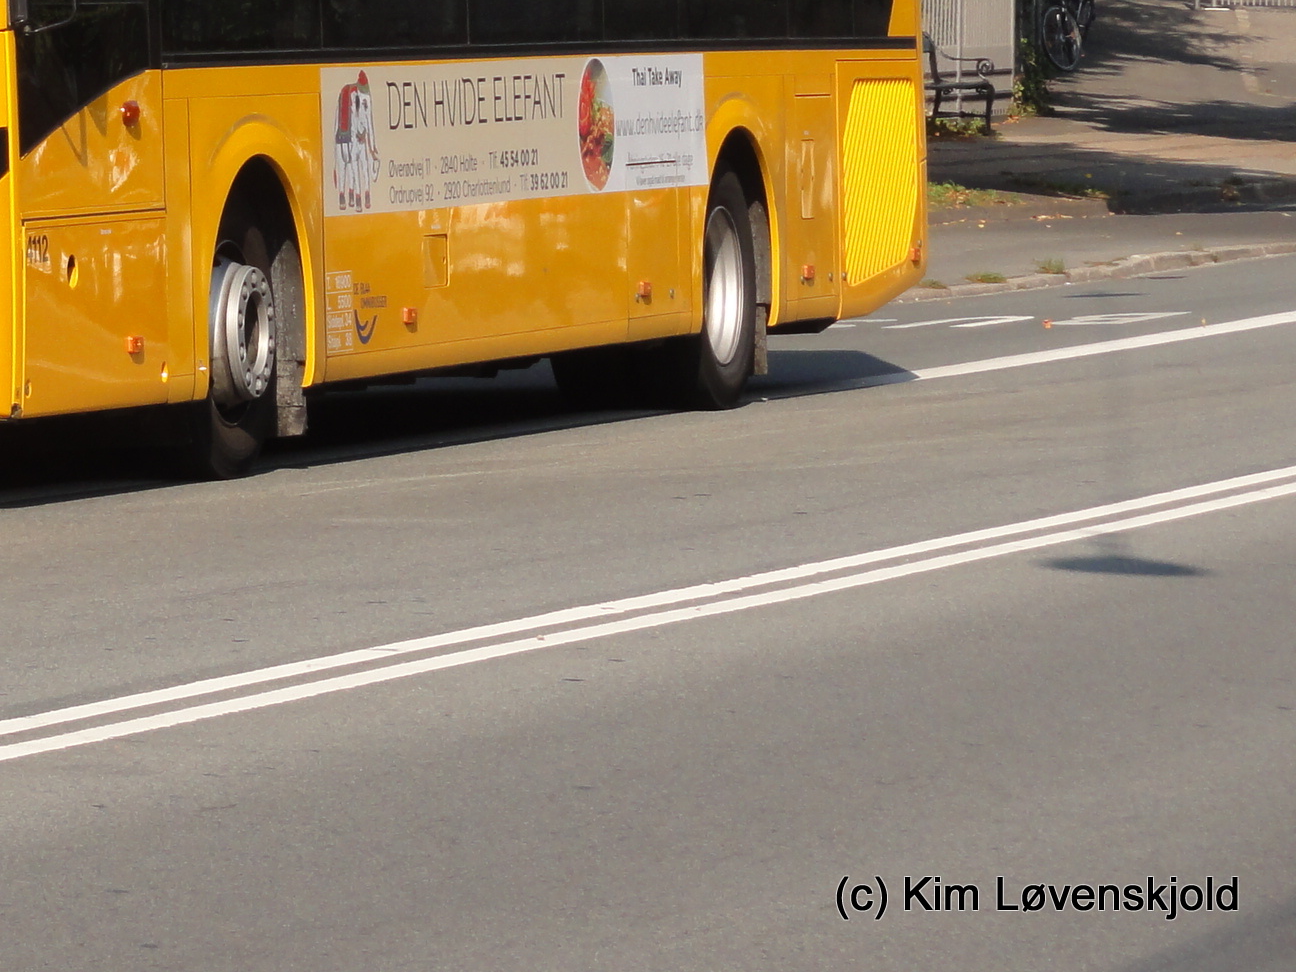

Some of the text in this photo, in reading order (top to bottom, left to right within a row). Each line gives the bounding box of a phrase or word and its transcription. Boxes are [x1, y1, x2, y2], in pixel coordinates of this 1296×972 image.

[632, 66, 682, 88] Thai Take Away
[386, 73, 565, 130] DEN HVIDE ELEFANT
[440, 155, 459, 175] 2840
[460, 154, 478, 173] Holte
[500, 150, 509, 168] 45
[510, 149, 519, 167] 54
[520, 149, 530, 166] 00
[531, 148, 539, 166] 21
[425, 184, 434, 202] 92
[443, 181, 461, 200] 2920
[462, 178, 511, 198] Charlottenlund
[530, 173, 539, 191] 39
[540, 172, 549, 190] 62
[550, 172, 559, 189] 00
[560, 171, 568, 188] 21
[27, 234, 49, 264] 4112
